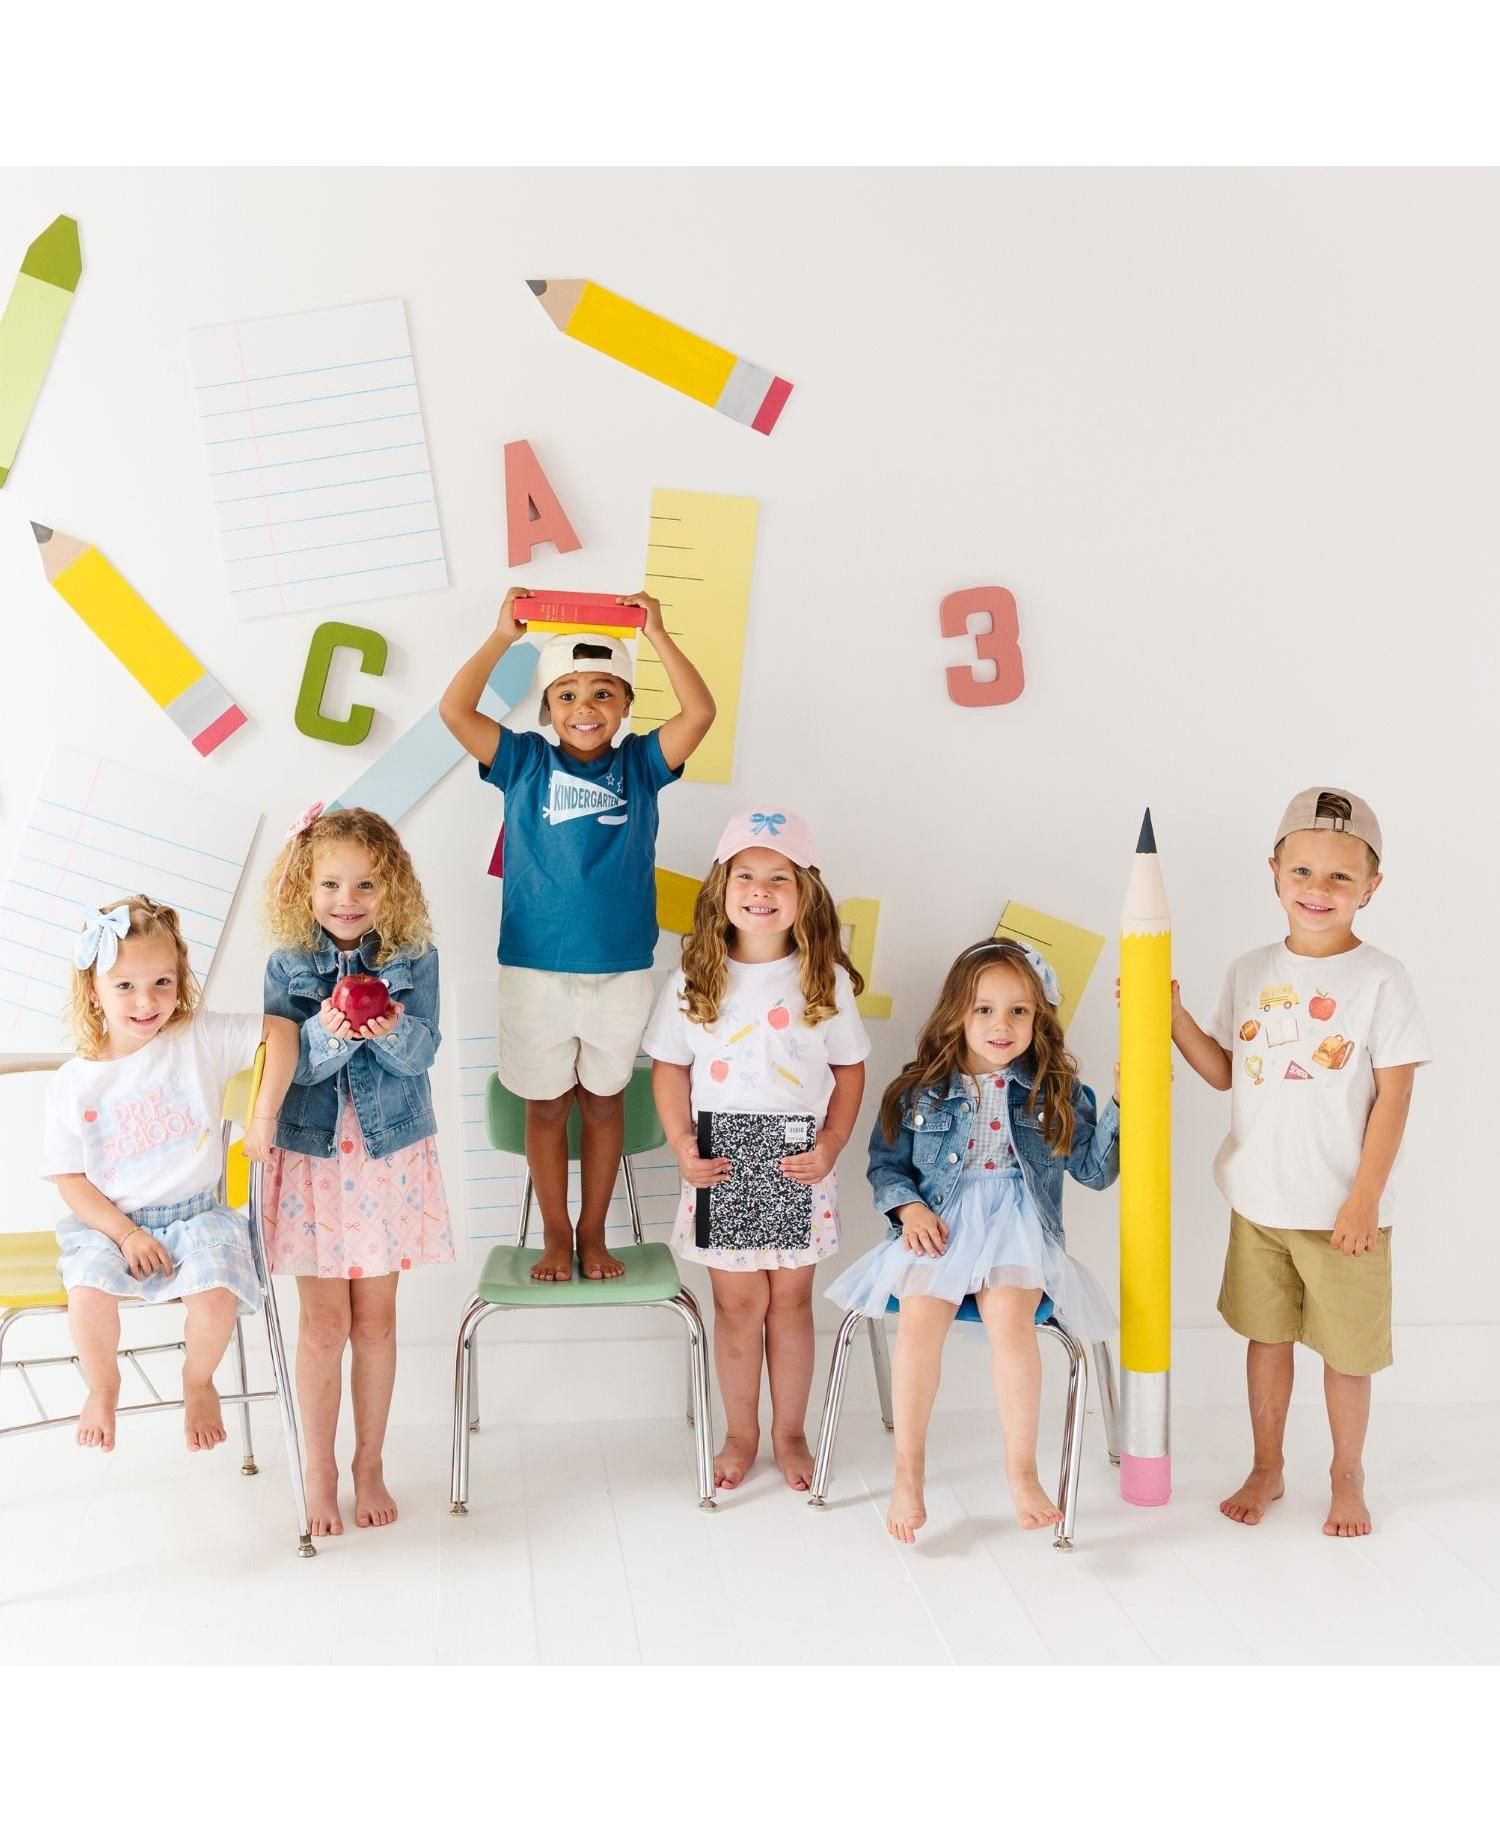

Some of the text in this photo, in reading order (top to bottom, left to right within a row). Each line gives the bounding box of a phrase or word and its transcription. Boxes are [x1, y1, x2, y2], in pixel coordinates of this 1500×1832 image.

[503, 439, 583, 568] A
[294, 621, 388, 746] C
[939, 586, 1025, 707] 3
[554, 784, 619, 811] KINDERGARTEN
[1289, 1064, 1309, 1079] SCHOOL
[102, 1104, 199, 1165] SCHOOL
